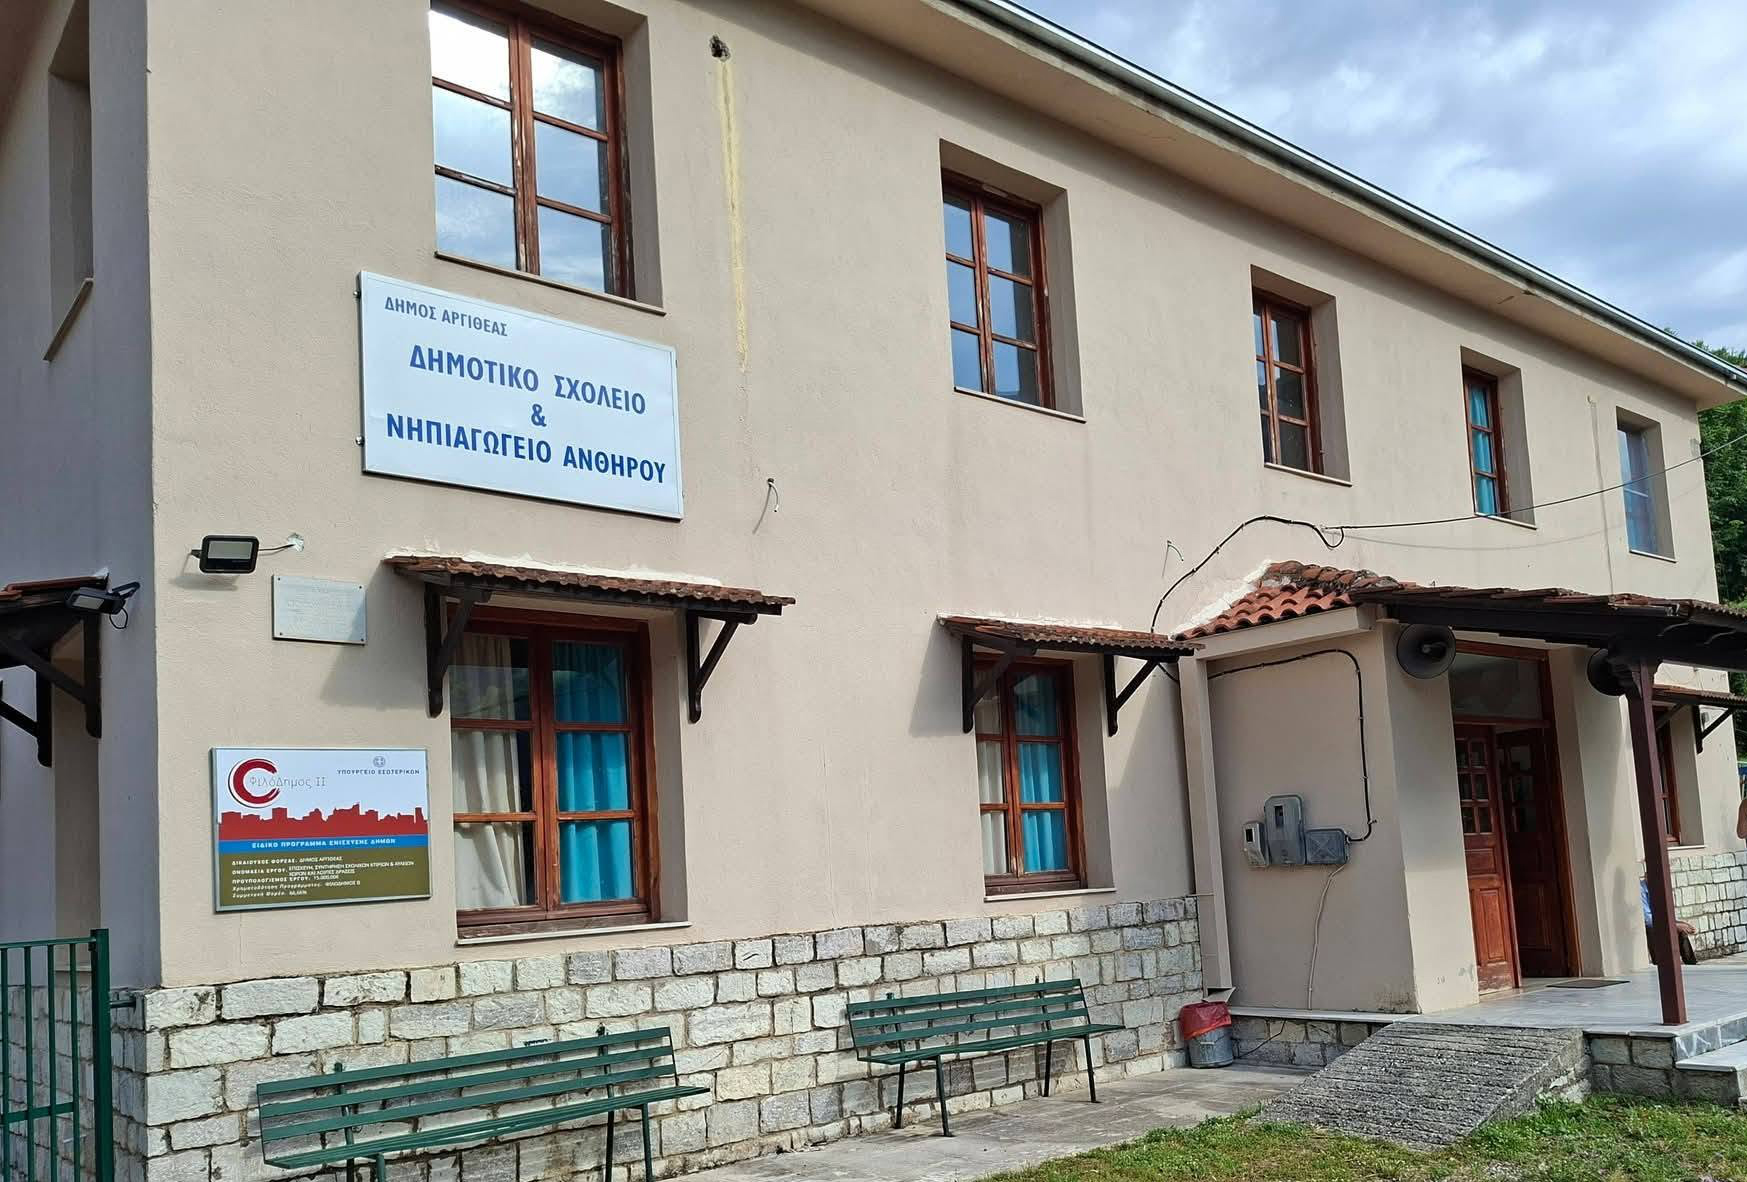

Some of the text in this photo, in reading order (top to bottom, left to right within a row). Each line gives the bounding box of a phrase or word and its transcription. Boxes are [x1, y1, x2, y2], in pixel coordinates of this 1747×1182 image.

[385, 297, 508, 337] ΔΗΜΟΣ ΑΡΓΙΘΕΑΣ
[410, 344, 646, 414] ΔΗΜΟΤΙΚΟ ΣΧΟΛΕΙΟ
[531, 403, 547, 427] &
[386, 413, 666, 484] ΝΗΠΙΑΓΩΓΕΙΟ ΑΝΘΗΡΟΥ
